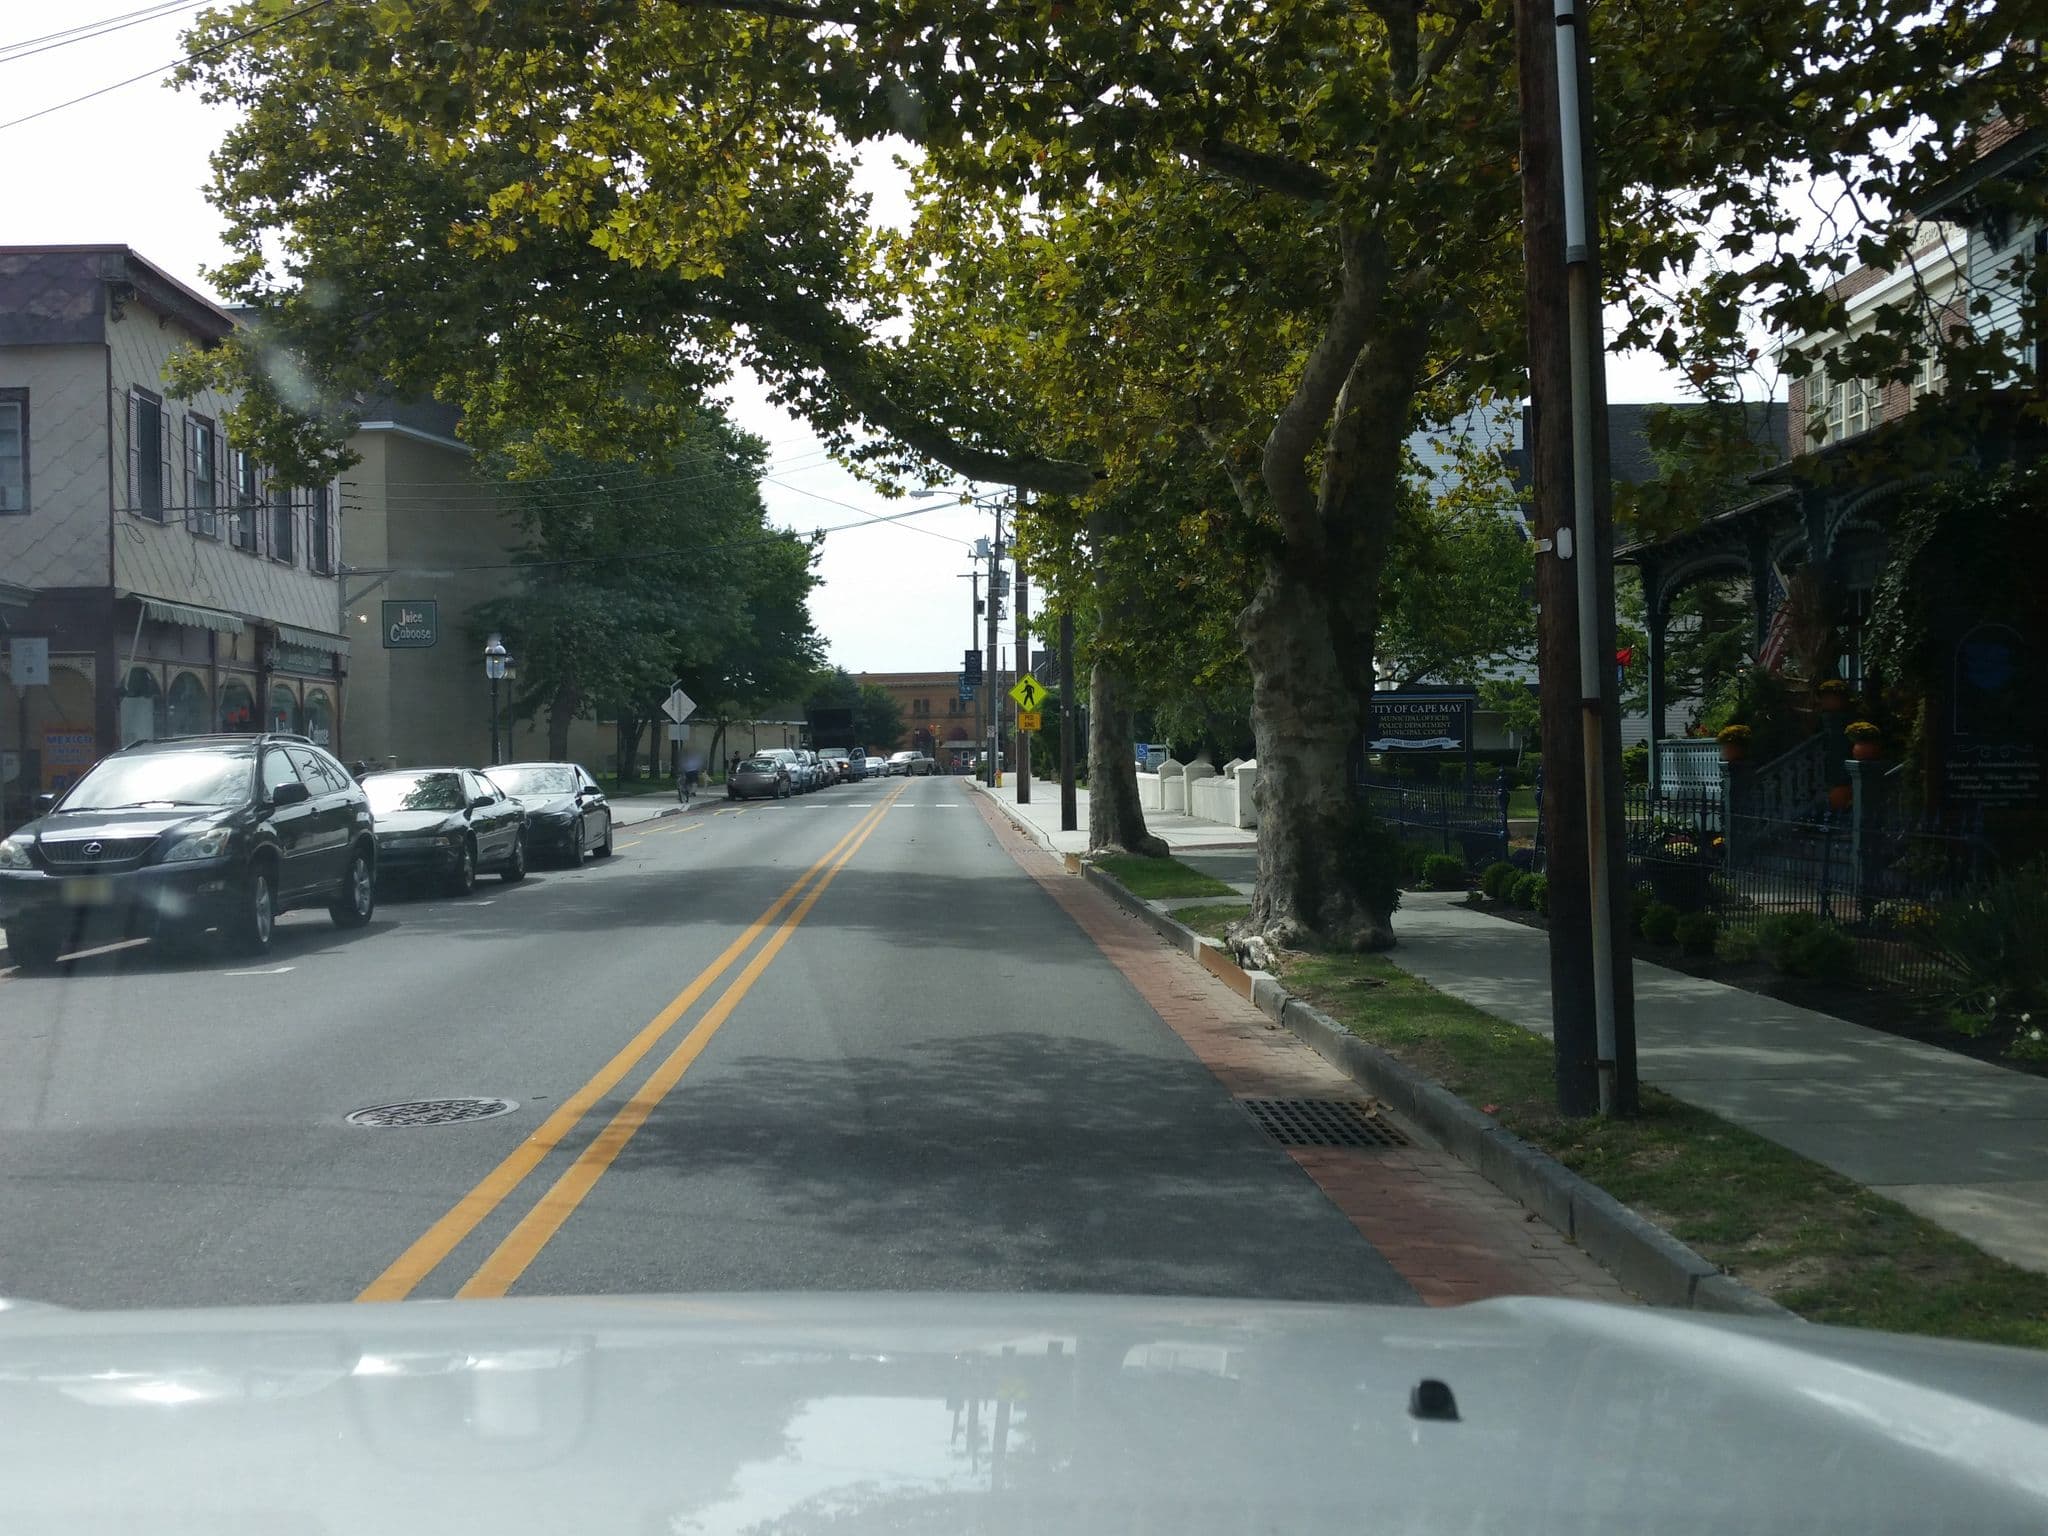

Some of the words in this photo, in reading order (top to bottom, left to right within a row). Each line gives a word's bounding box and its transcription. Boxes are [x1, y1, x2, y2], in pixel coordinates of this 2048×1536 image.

[398, 608, 423, 626] Juice
[390, 623, 431, 642] Caboose
[1394, 704, 1409, 713] OF
[1410, 704, 1437, 713] CAPE
[1439, 703, 1463, 713] MAY
[1381, 714, 1420, 723] MUNICIPAL
[1378, 721, 1403, 729] POLICE
[1404, 721, 1452, 729] DEPARTMENT
[1423, 728, 1447, 736] COURT
